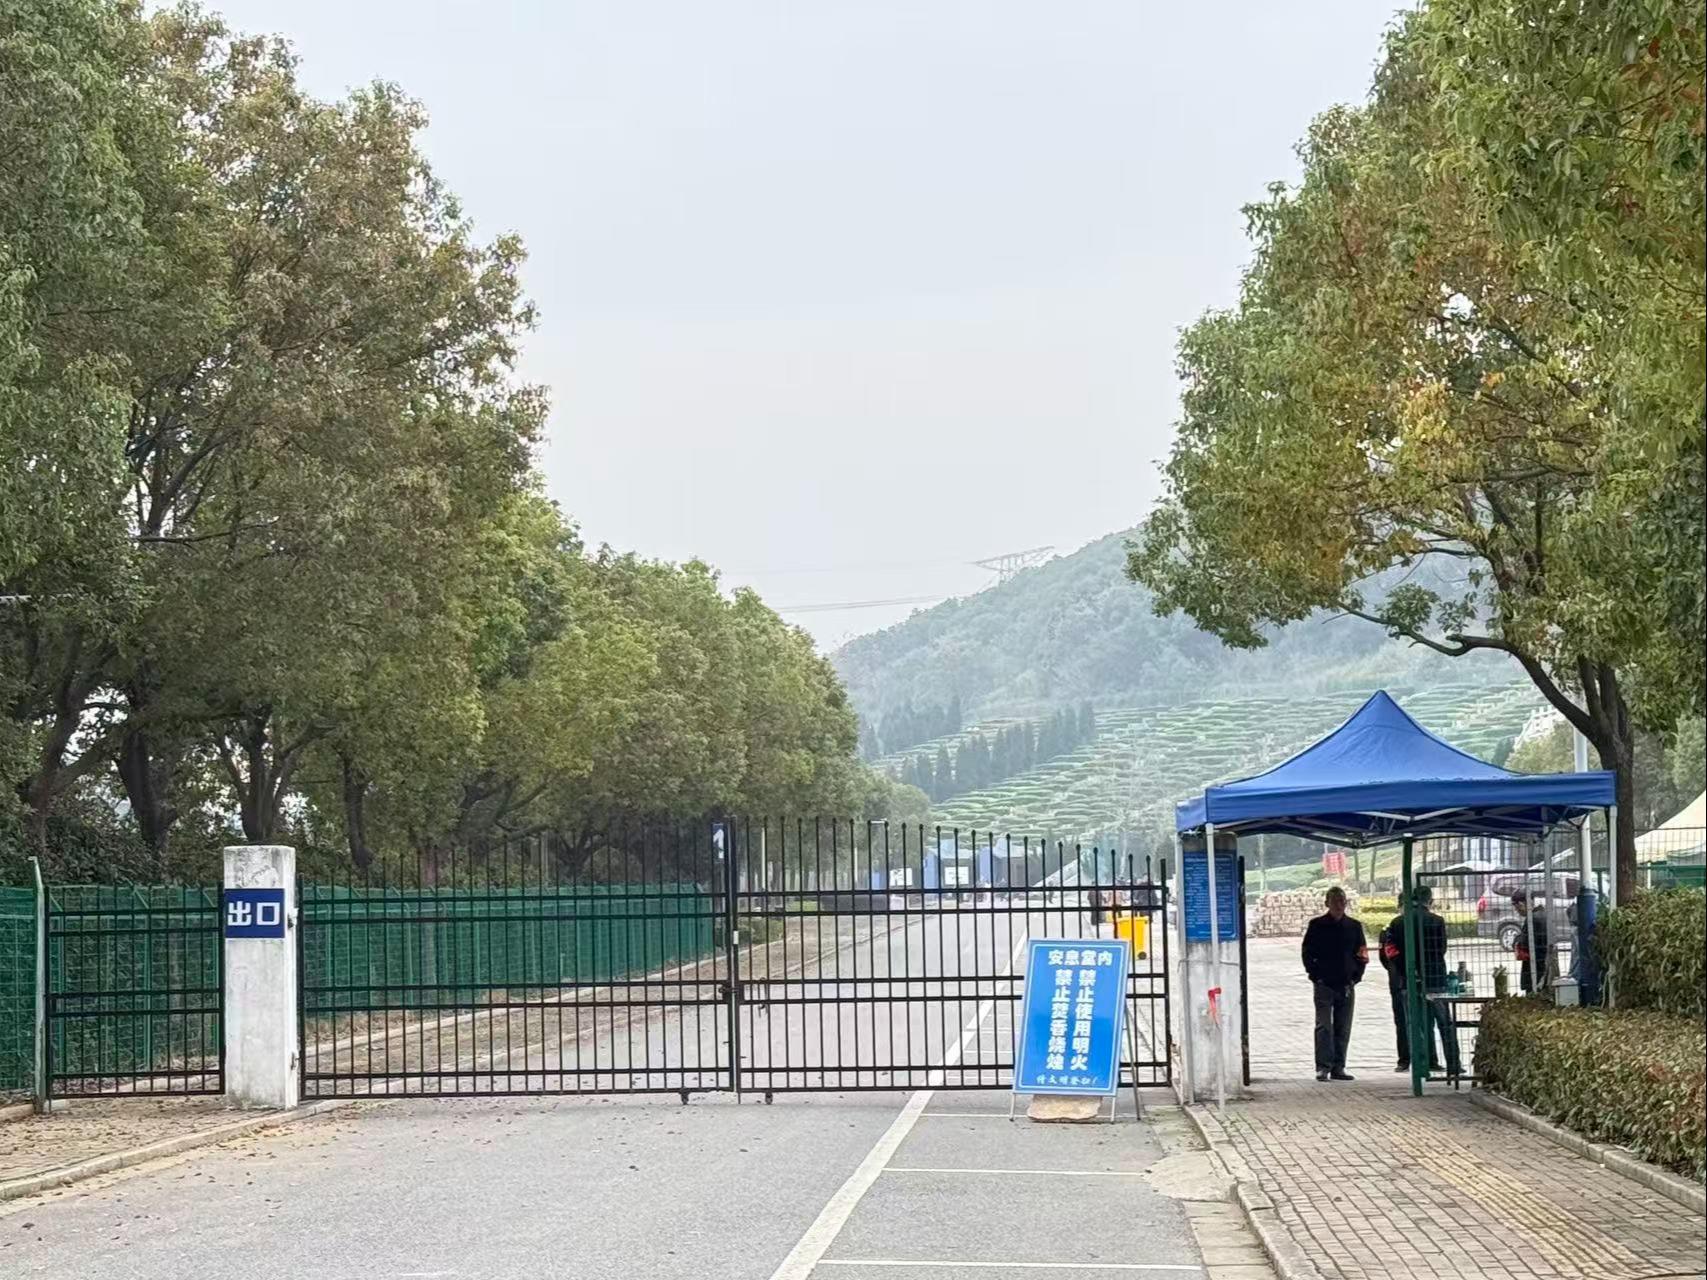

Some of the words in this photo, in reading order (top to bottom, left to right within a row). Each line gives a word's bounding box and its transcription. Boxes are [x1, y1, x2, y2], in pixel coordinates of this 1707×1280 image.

[227, 900, 280, 926] 出口
[1069, 969, 1097, 1071] 禁止使用明火
